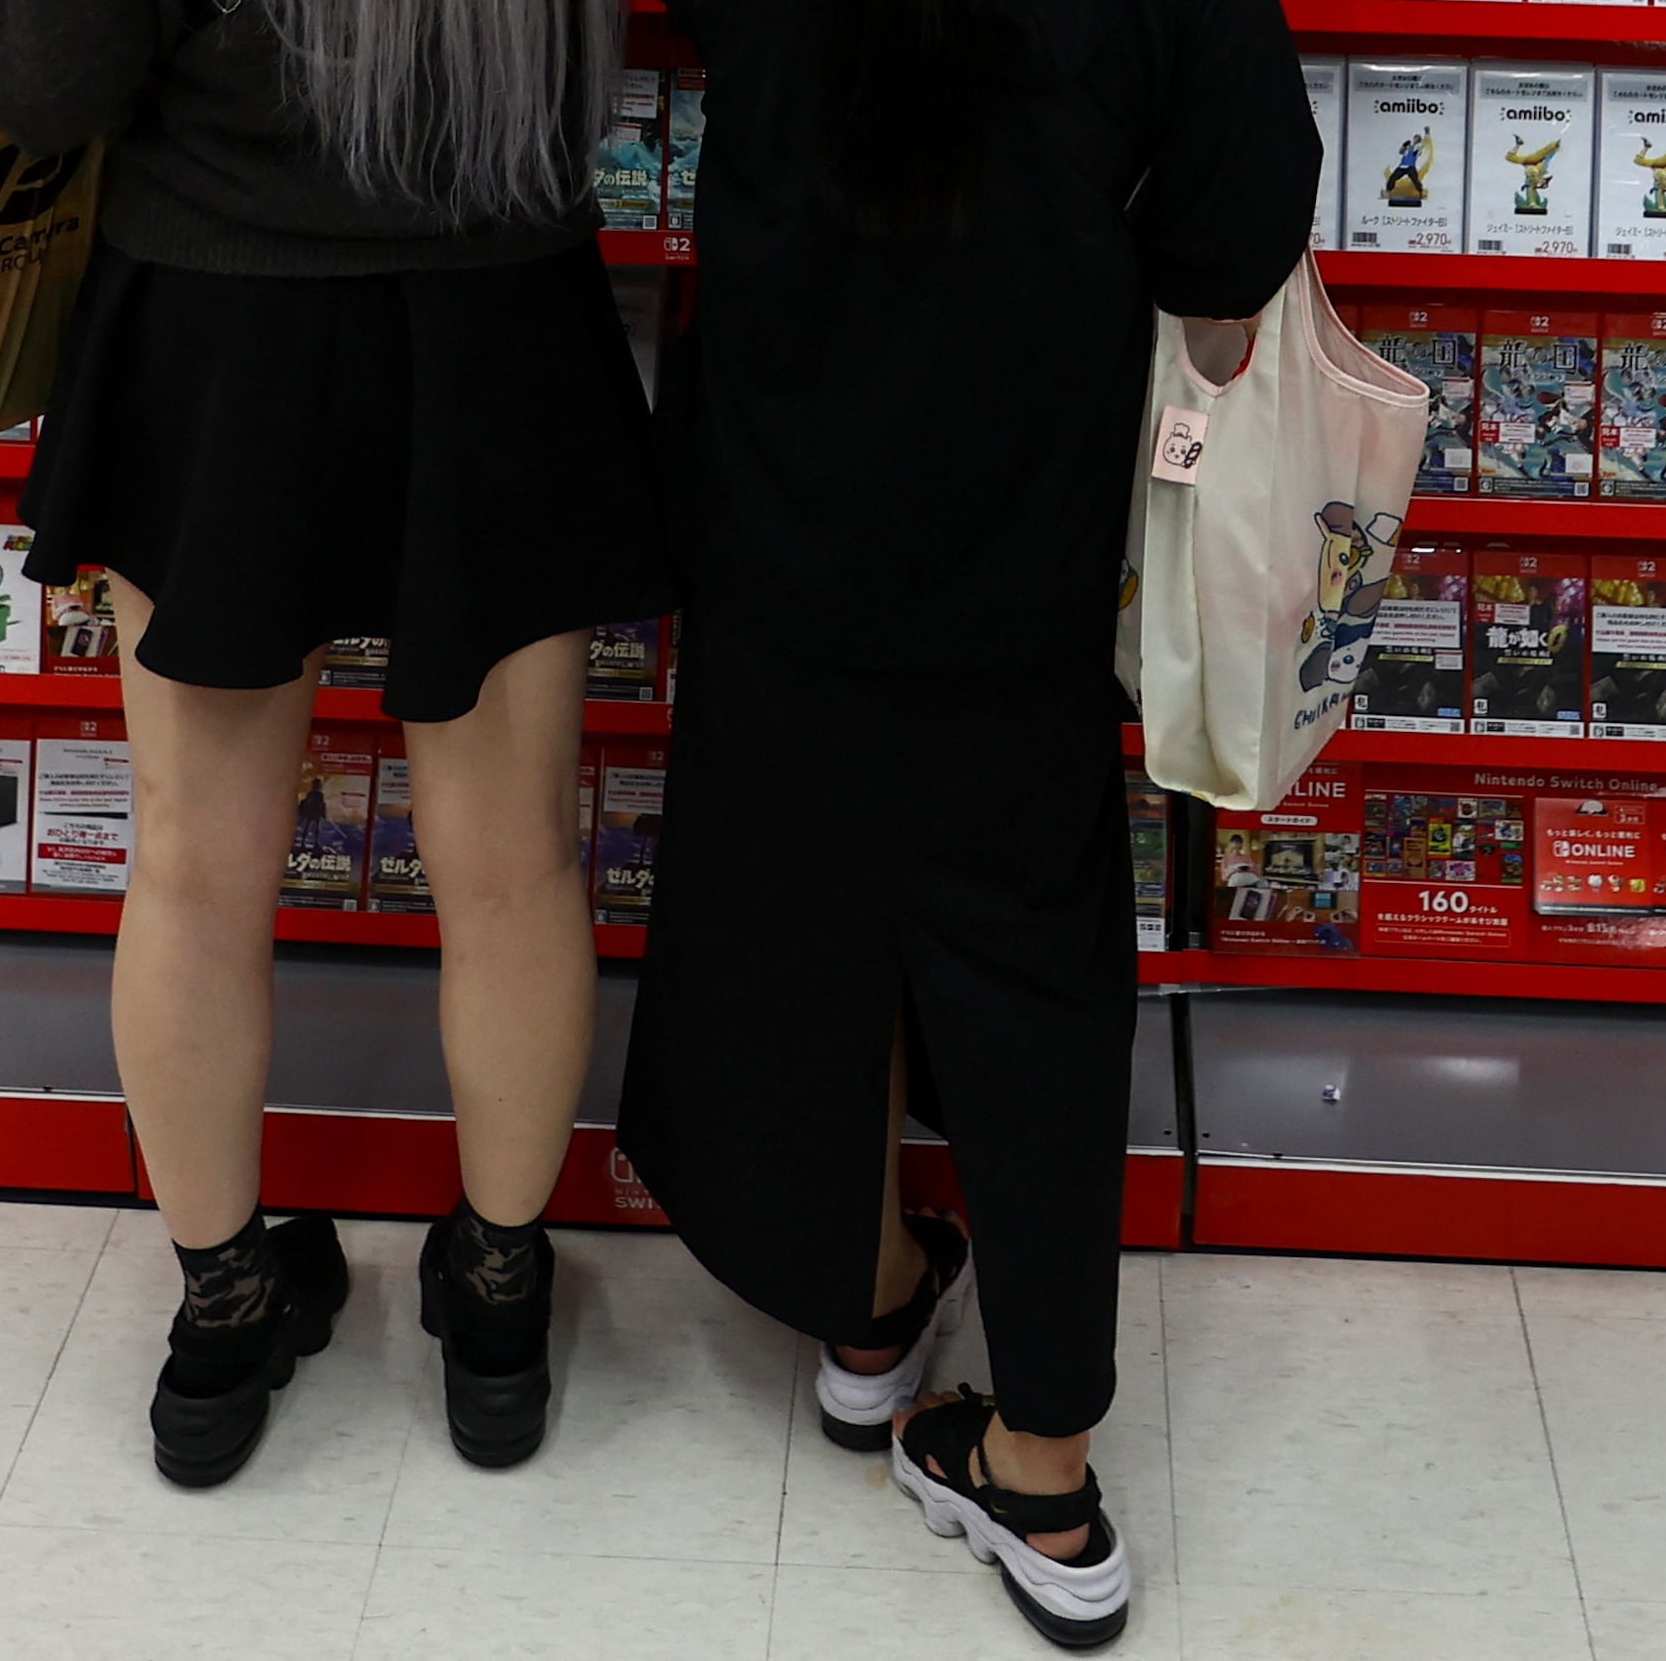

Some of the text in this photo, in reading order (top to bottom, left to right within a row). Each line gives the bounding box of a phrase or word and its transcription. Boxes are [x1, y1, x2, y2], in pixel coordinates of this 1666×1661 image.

[1380, 100, 1438, 114] amiibo
[1506, 107, 1565, 122] amiibo
[1475, 773, 1658, 793] Nintendo Switch Online
[1571, 842, 1636, 859] ONLINE
[1419, 890, 1469, 913] 160
